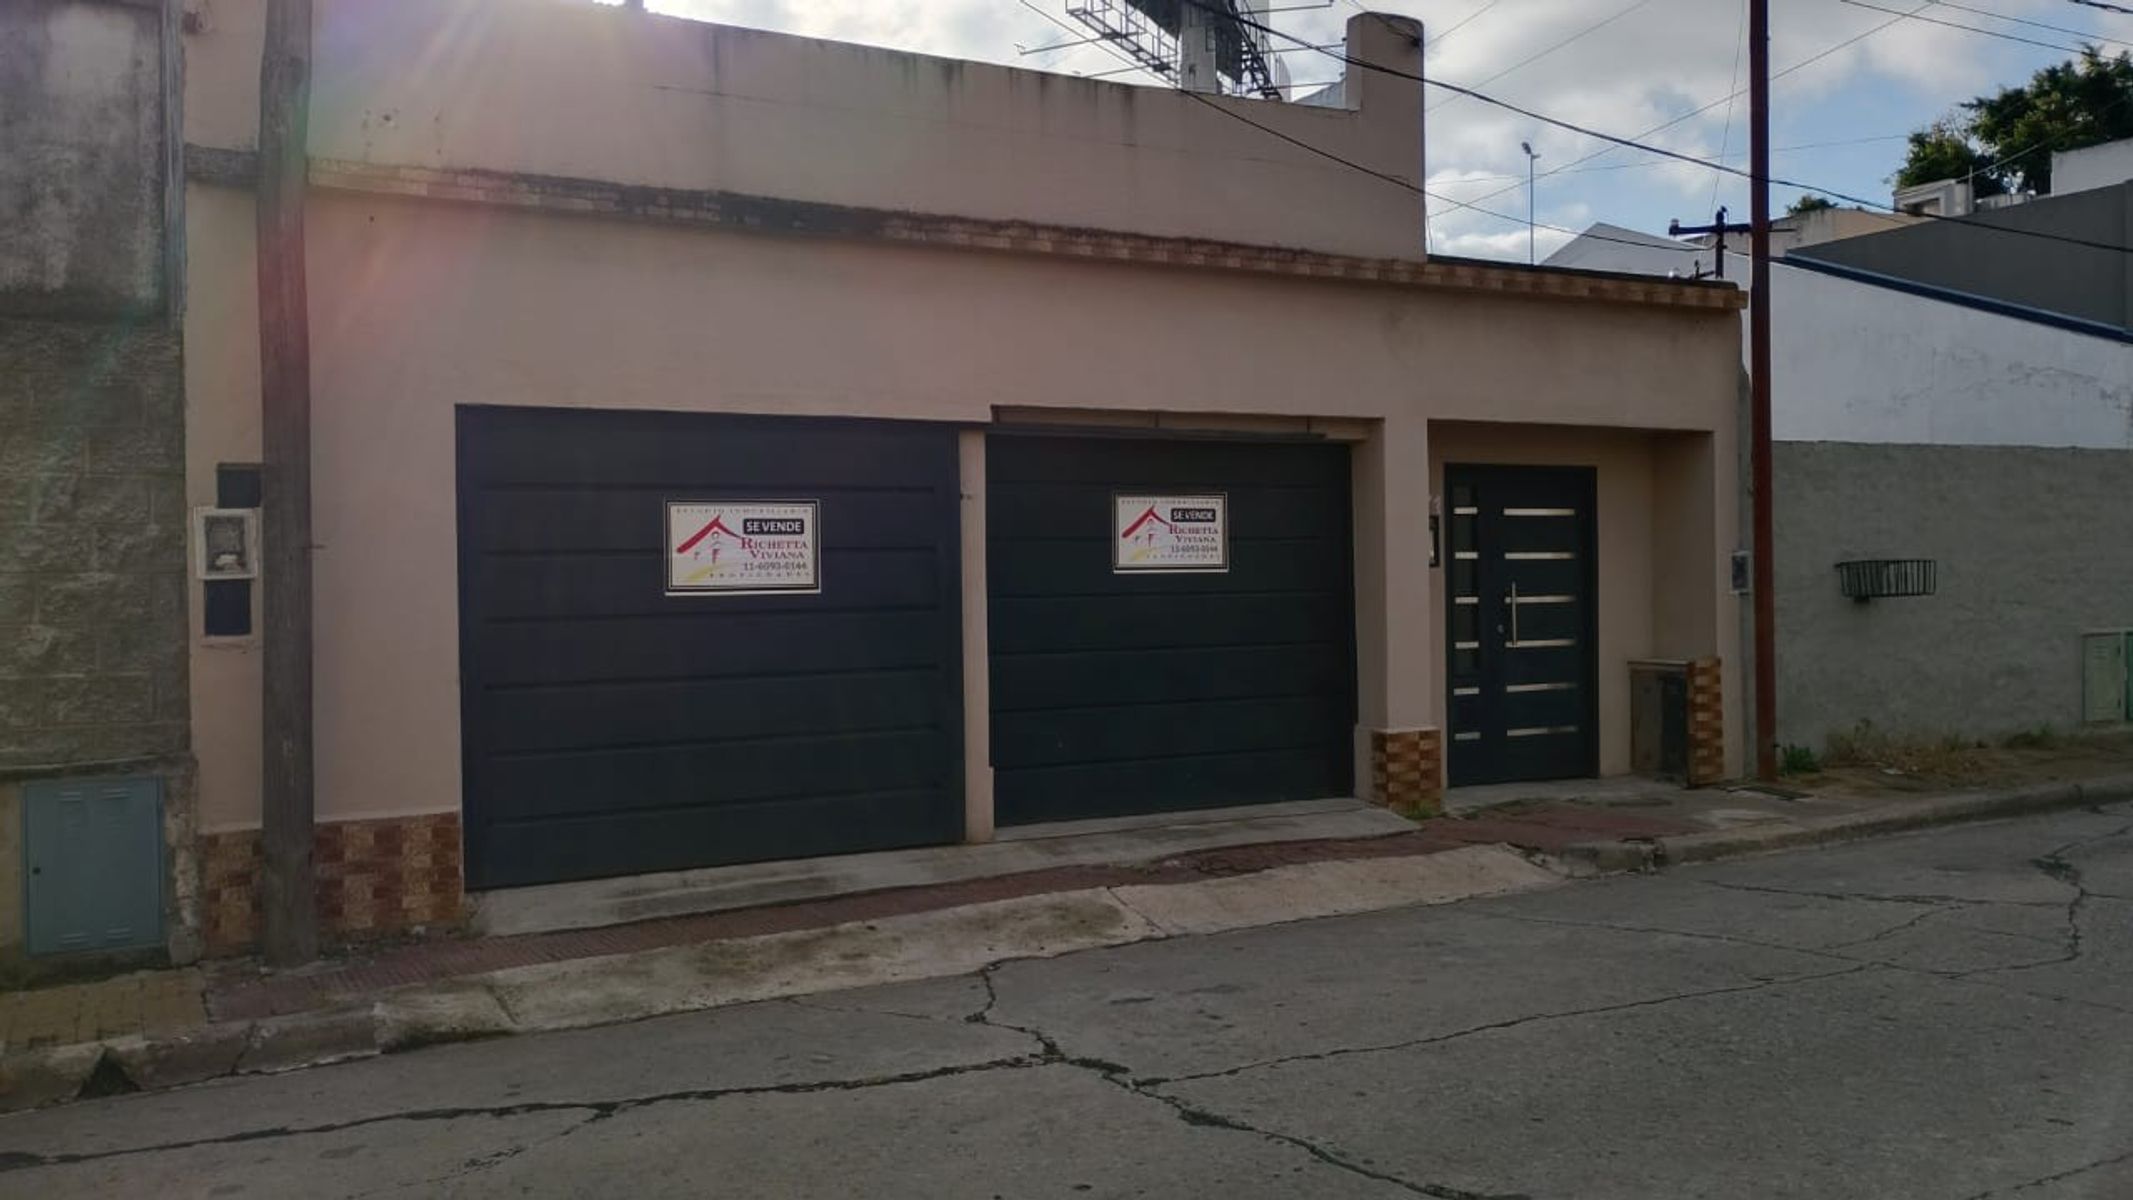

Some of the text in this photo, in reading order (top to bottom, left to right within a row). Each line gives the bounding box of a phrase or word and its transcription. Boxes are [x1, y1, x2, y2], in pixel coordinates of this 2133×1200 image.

[1173, 510, 1215, 520] SE VENDE
[746, 520, 802, 532] SE VENDE
[741, 537, 808, 550] RICHETTA
[751, 550, 805, 560] VIVIANA
